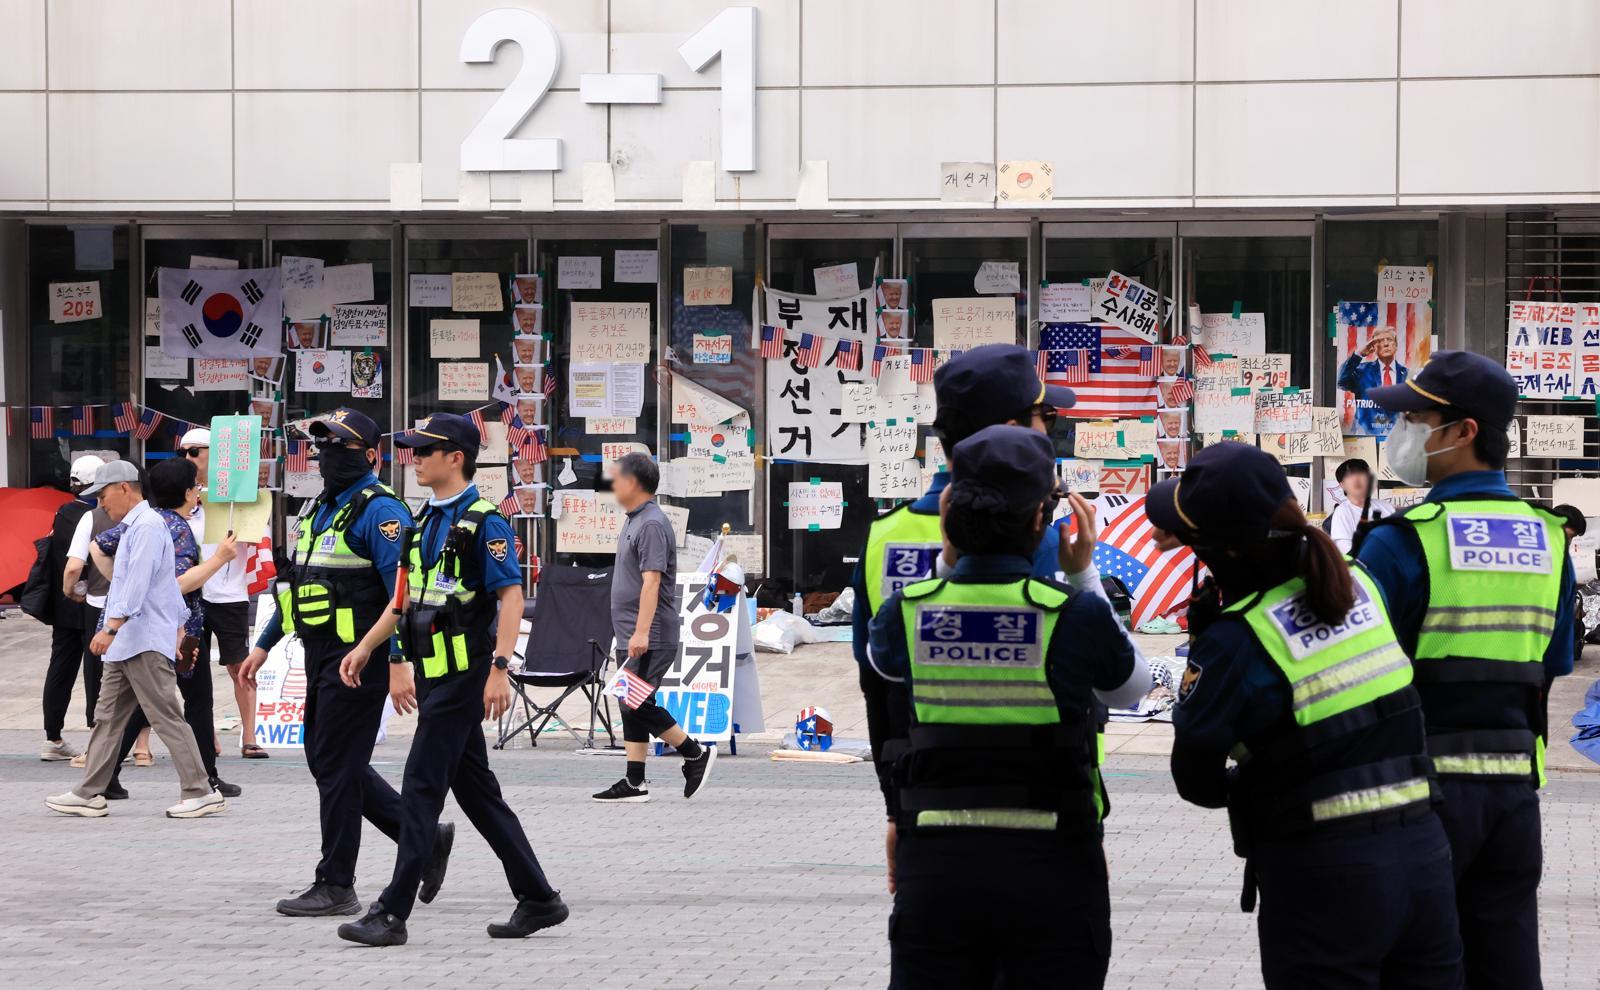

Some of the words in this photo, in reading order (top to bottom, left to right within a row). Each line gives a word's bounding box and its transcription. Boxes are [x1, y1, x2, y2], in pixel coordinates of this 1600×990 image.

[460, 7, 757, 171] 2-1
[945, 171, 989, 188] 재선거
[63, 300, 94, 317] 20명
[578, 306, 615, 321] 투표용지
[1512, 304, 1575, 323] 국제기관
[588, 323, 628, 338] 증거보존
[695, 338, 731, 355] 재선거
[1460, 519, 1539, 548] 경찰
[1463, 549, 1541, 566] POLICE
[924, 611, 1028, 642] 경찰
[929, 645, 1027, 662] POLICE
